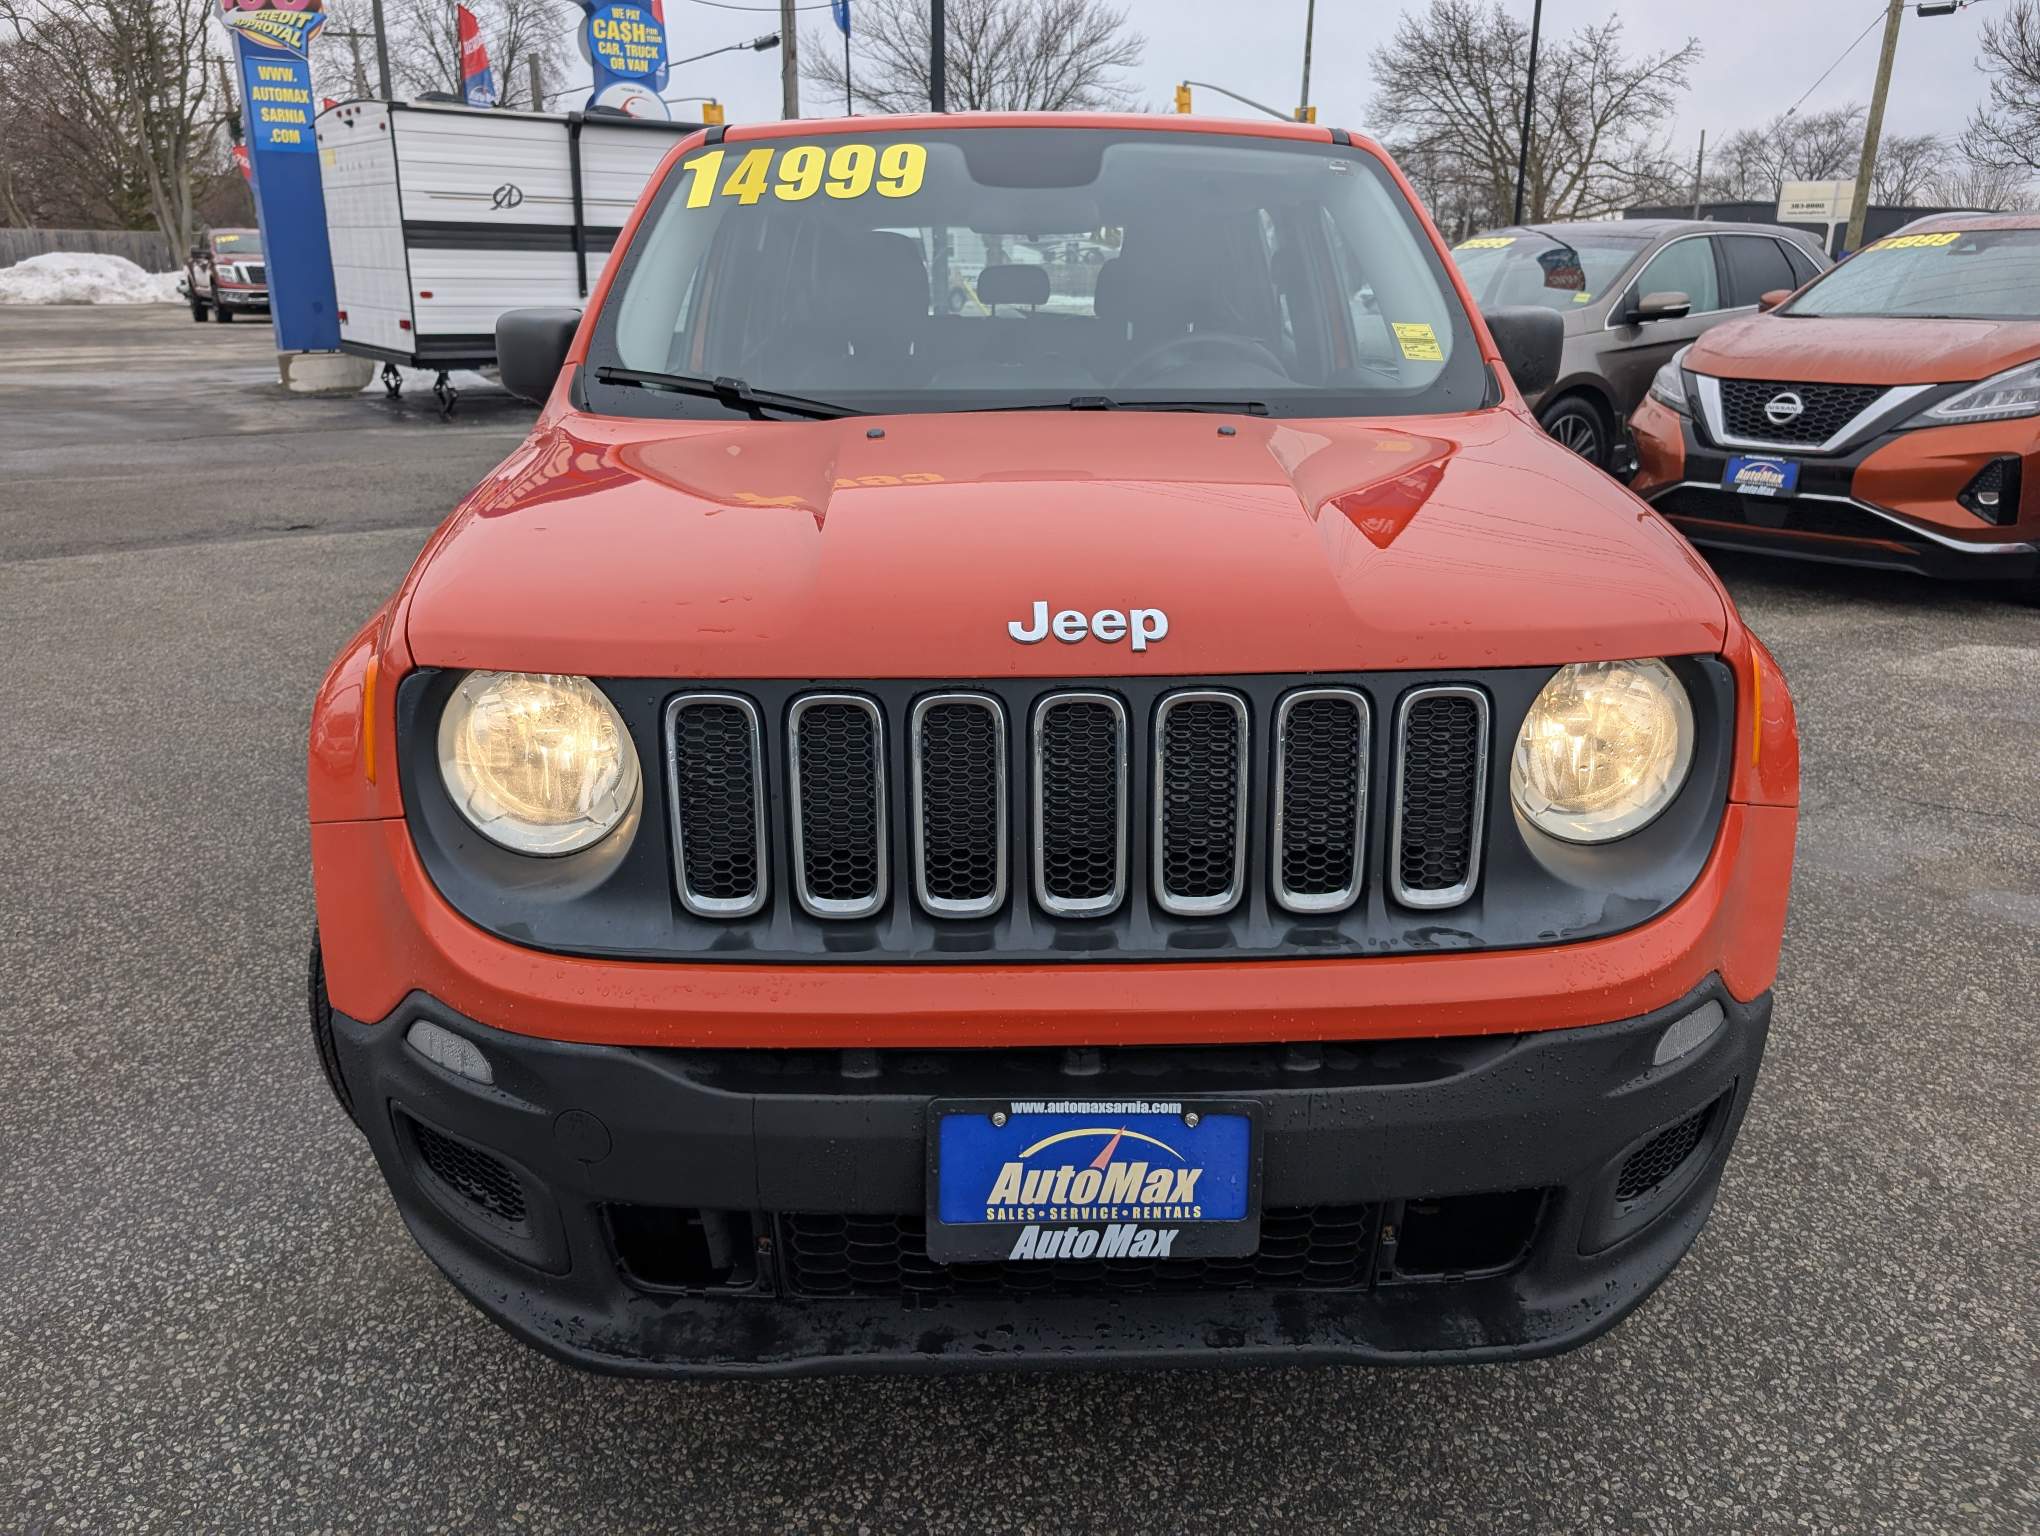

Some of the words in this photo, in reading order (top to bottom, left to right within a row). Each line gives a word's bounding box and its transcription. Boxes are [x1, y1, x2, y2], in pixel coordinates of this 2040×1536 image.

[256, 11, 312, 28] CREDIT
[233, 19, 302, 48] APPROVAL
[625, 45, 658, 59] TRUCK
[610, 58, 625, 70] OR
[627, 59, 648, 72] VAN
[253, 86, 309, 103] AUTOMAX
[261, 107, 306, 123] SARNIA
[683, 143, 927, 209] 14999
[1767, 404, 1798, 412] NISSAN
[1008, 601, 1168, 651] Jeep
[1011, 1101, 1182, 1114] www.automaxsarnia.com
[986, 1162, 1203, 1205] AutoMax
[1049, 1206, 1119, 1220] SERVICE
[1132, 1205, 1202, 1219] RENTALS
